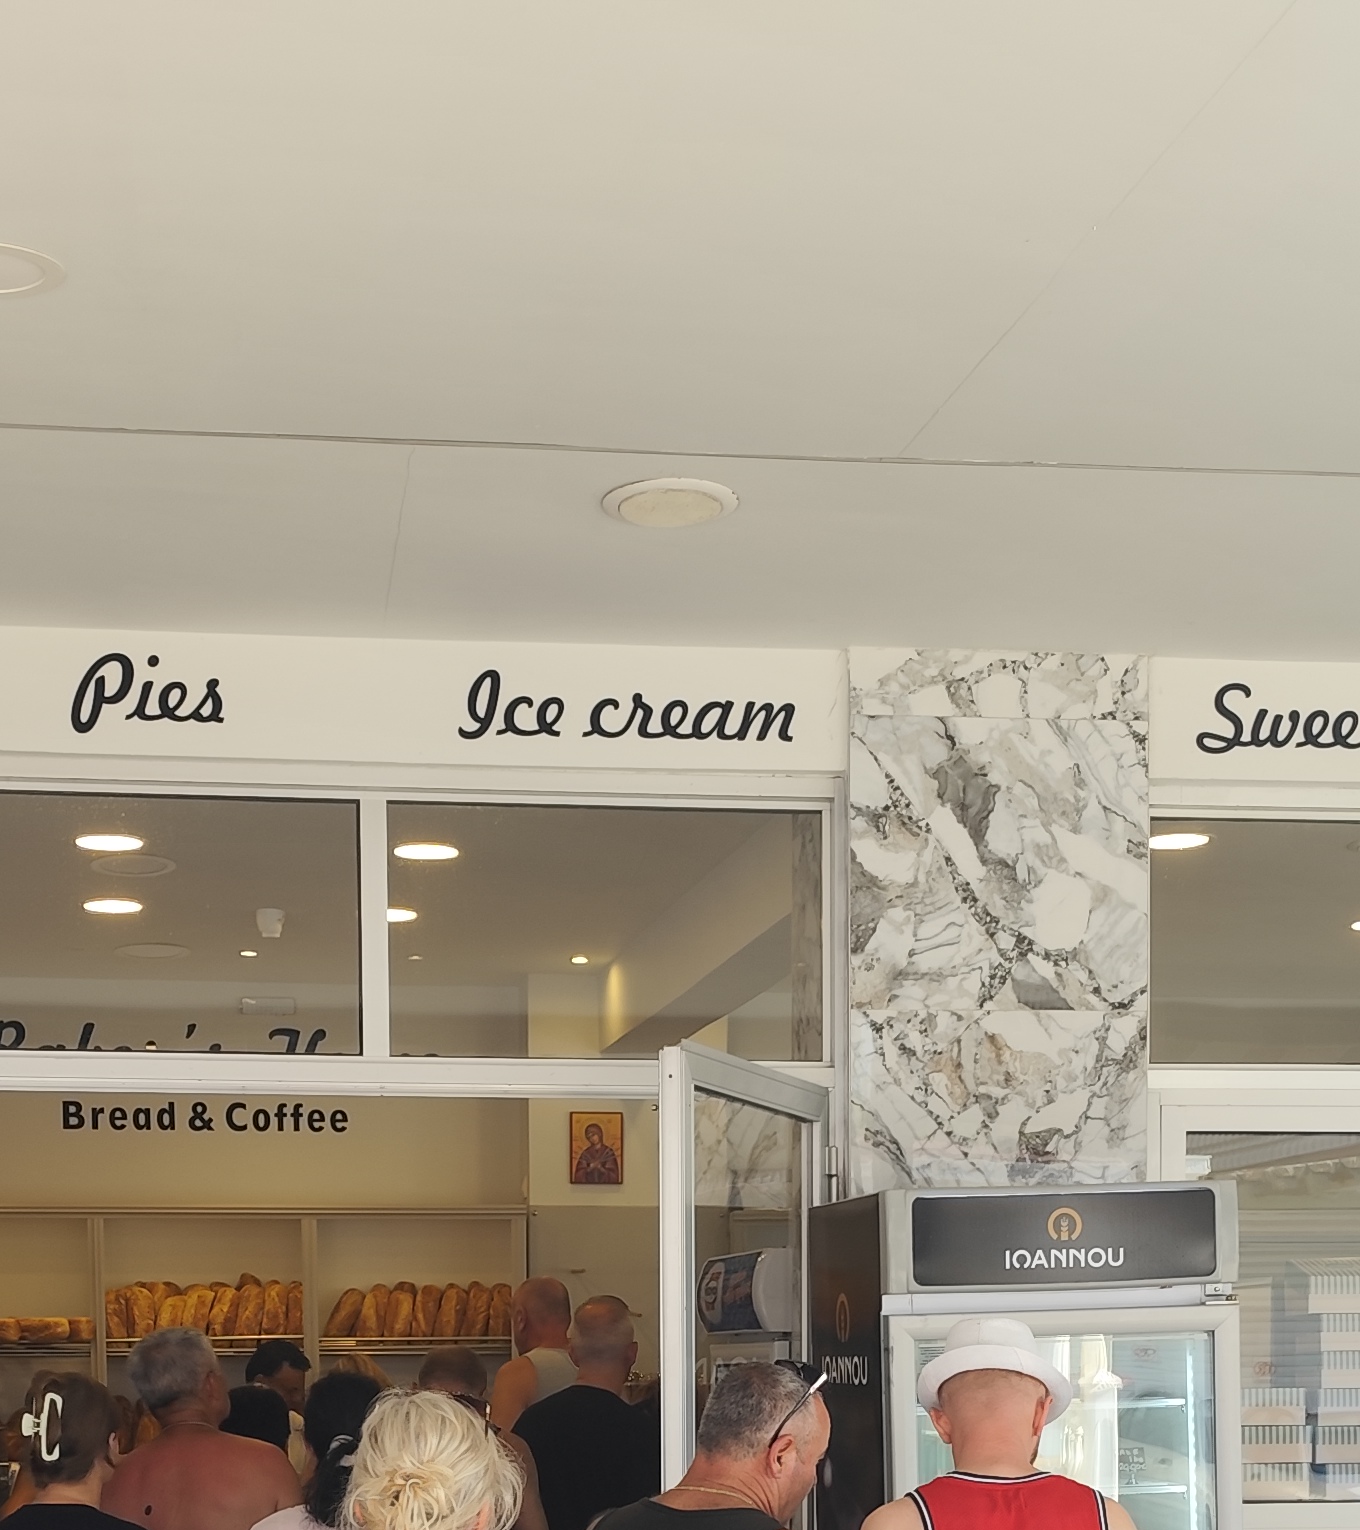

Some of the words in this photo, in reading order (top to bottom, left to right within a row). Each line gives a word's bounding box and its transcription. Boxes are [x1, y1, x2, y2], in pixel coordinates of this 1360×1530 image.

[70, 651, 226, 735] Pies
[458, 668, 566, 740] Ice
[582, 690, 797, 742] cream
[61, 1100, 176, 1131] Bread
[187, 1103, 215, 1132] &
[225, 1102, 349, 1133] Coffee
[1004, 1247, 1125, 1270] IOANNOU
